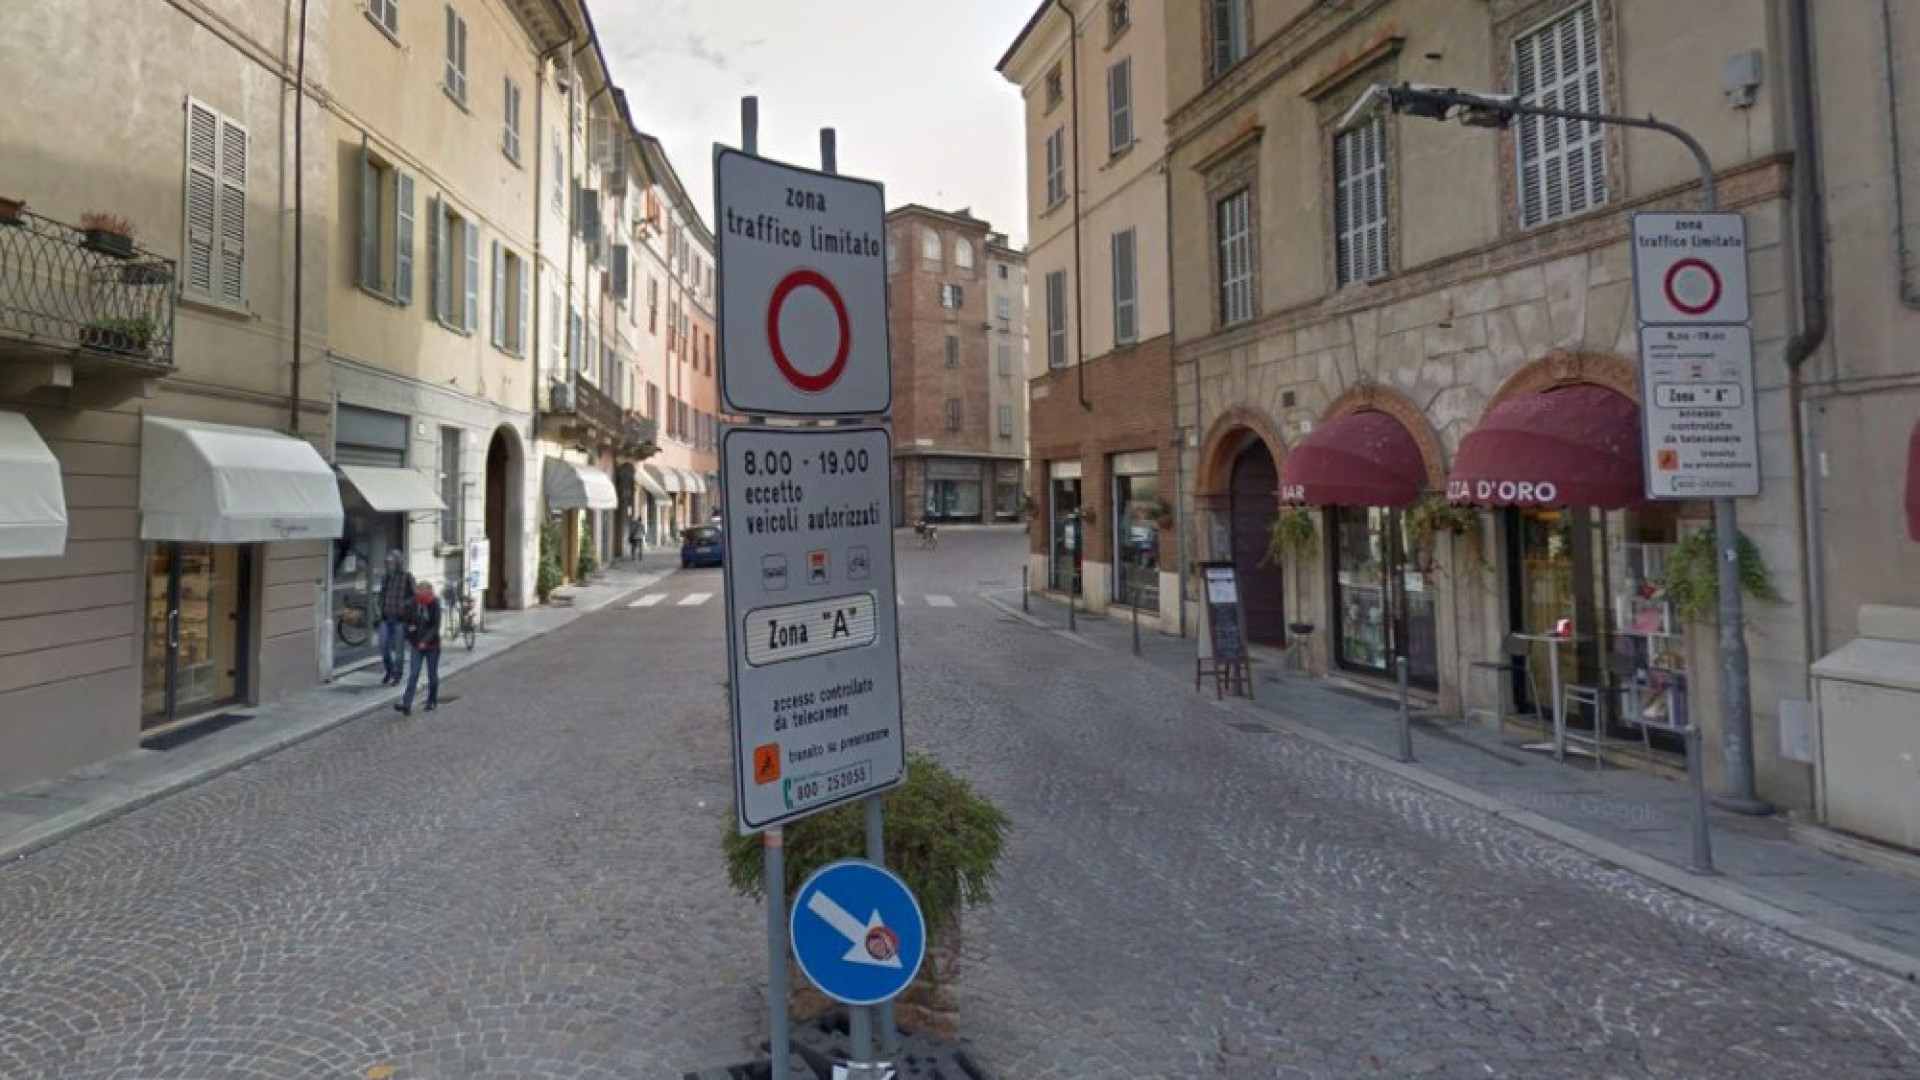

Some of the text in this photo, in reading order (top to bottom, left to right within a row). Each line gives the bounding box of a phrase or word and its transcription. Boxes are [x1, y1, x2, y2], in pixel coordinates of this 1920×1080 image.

[785, 187, 827, 212] zona
[727, 206, 881, 257] traffico limitato
[1675, 220, 1703, 230] zona
[1639, 235, 1742, 247] traffico limitato
[1669, 388, 1695, 402] Zona
[744, 450, 792, 476] 8.00
[745, 480, 803, 504] eccetto
[1477, 480, 1557, 502] D'ORO
[746, 501, 880, 534] veicoli autorizzati
[768, 606, 857, 649] Zona "A"
[773, 678, 874, 712] accesso controllato
[773, 703, 849, 732] da telecamere
